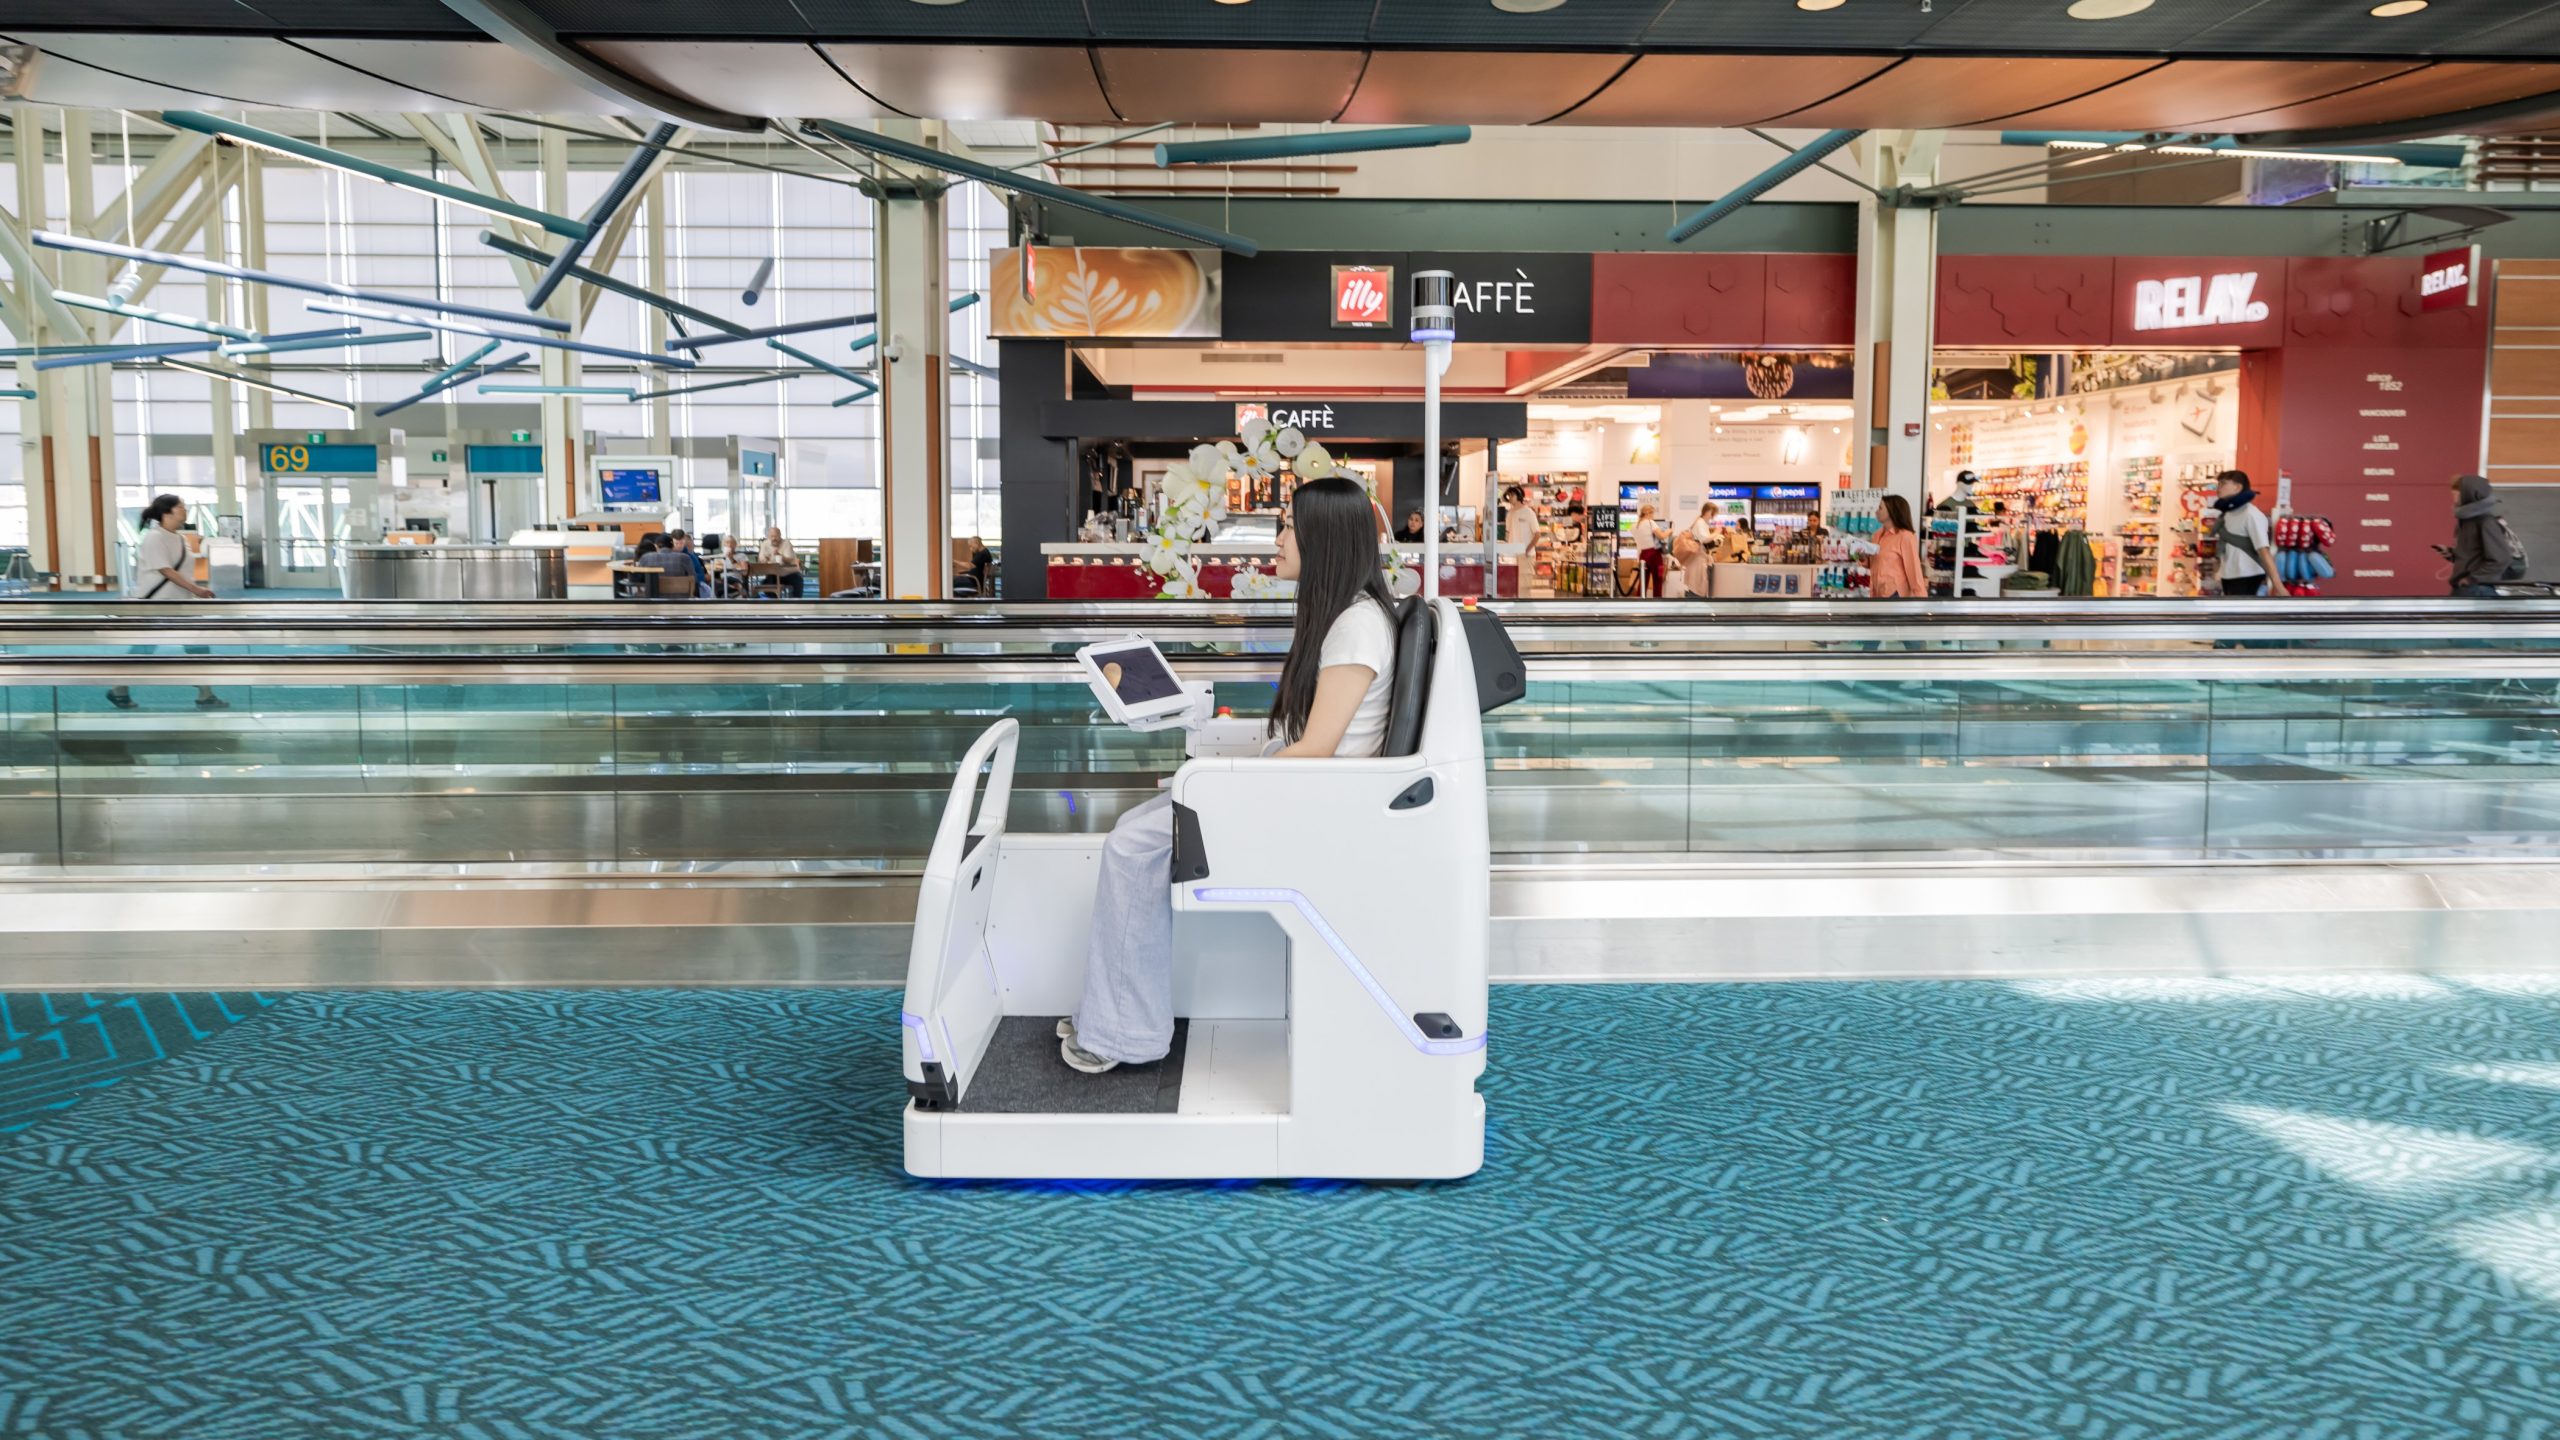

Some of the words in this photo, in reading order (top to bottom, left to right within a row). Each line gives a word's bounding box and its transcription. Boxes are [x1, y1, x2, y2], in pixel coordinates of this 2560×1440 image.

[1454, 268, 1535, 313] AFFÈ
[1340, 279, 1383, 317] illy
[1272, 404, 1335, 428] CAFFÈ
[2359, 409, 2407, 417] VANCOUVER
[270, 445, 309, 472] 69
[1714, 487, 1737, 498] pepsi
[1782, 487, 1806, 498] pepsi
[1596, 513, 1615, 521] LIFE
[1596, 521, 1615, 529] WTR
